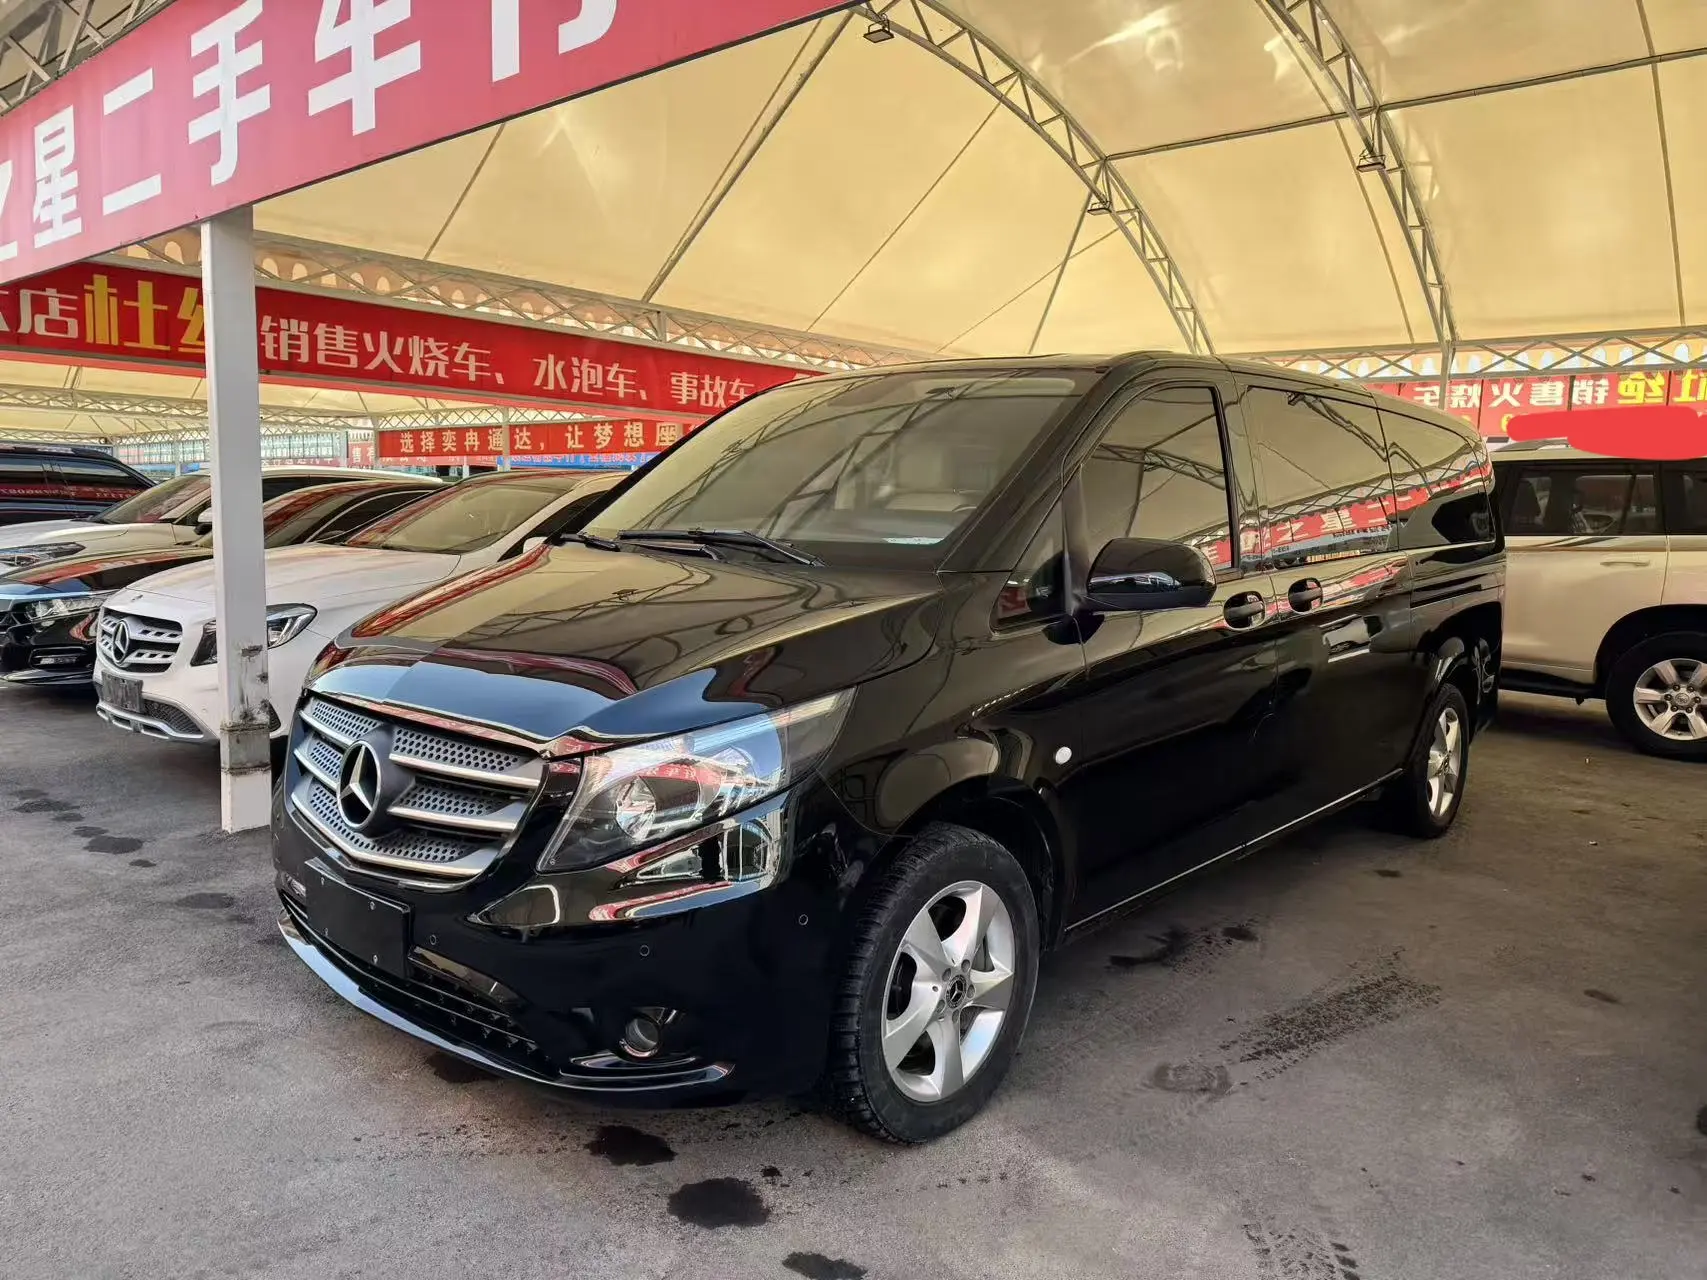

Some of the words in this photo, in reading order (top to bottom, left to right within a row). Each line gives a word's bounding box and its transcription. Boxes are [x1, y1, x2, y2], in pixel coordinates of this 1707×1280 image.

[400, 423, 695, 453] 选择奕冉通达，让梦想座
